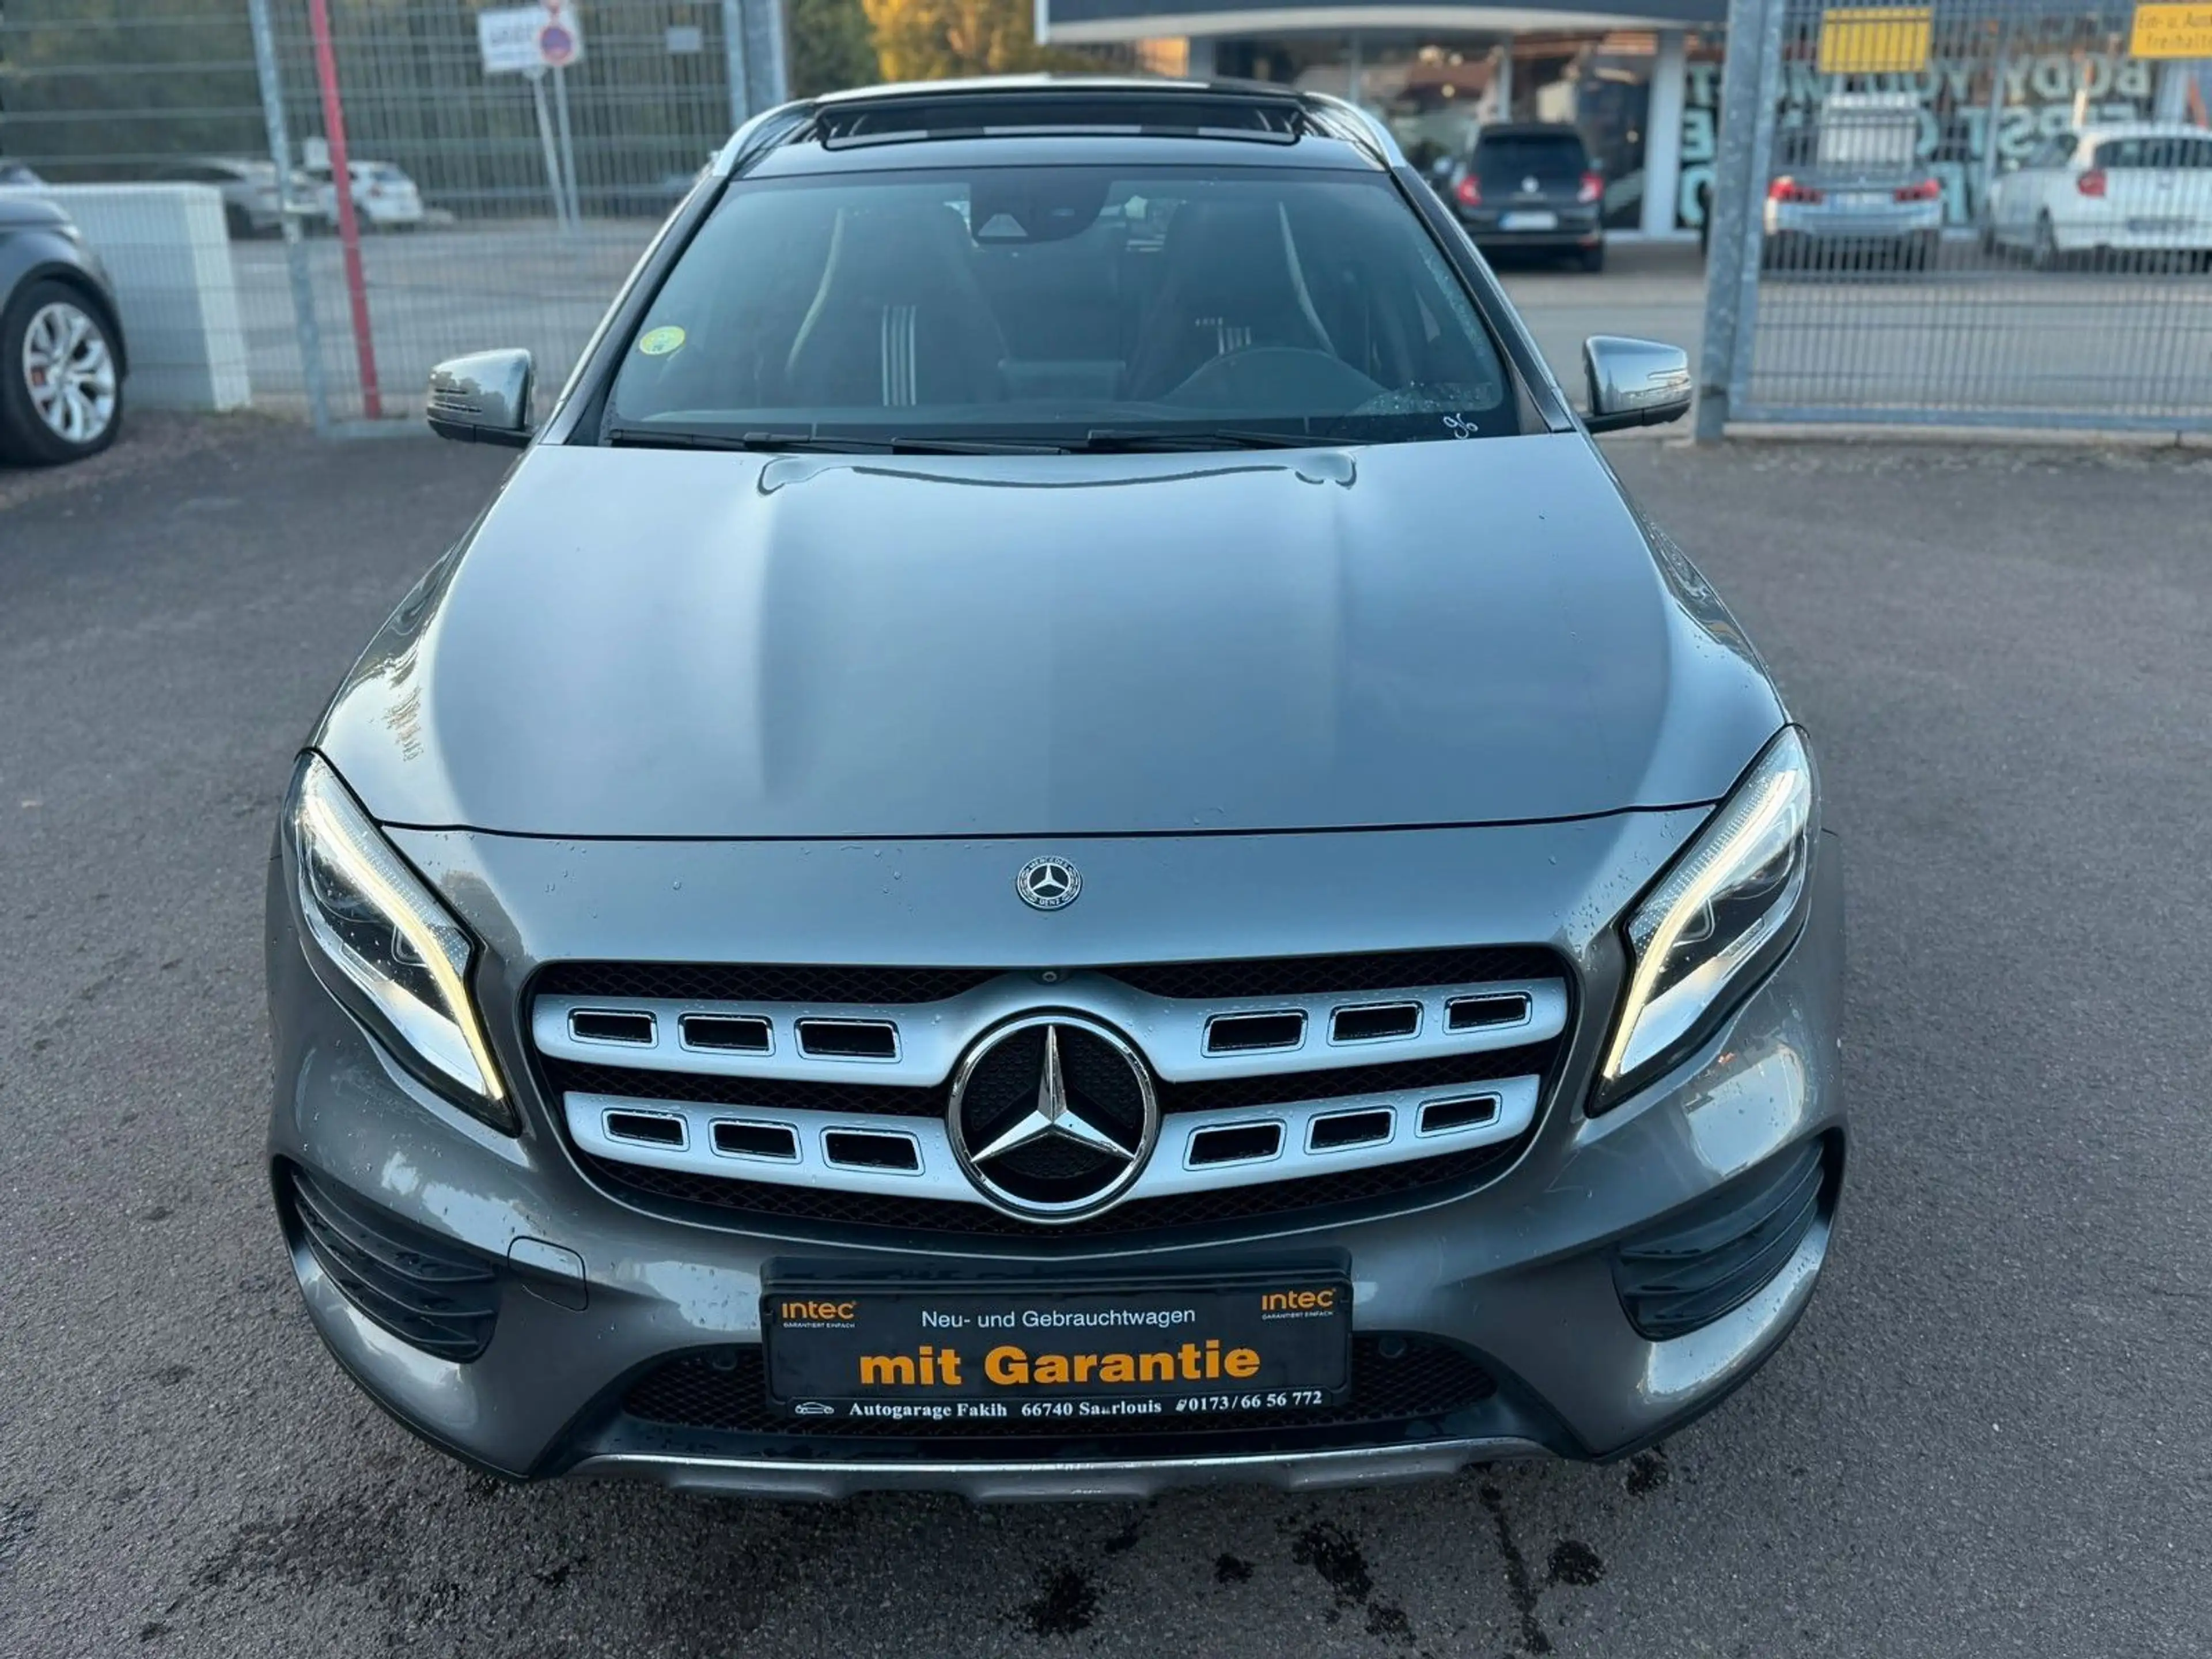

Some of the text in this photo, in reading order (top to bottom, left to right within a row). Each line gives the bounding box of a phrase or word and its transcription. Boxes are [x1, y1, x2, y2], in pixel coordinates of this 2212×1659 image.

[782, 1301, 854, 1319] intec
[1262, 1290, 1334, 1310] intec
[922, 1309, 1196, 1327] Neu- und Gebrauchtwagen
[860, 1339, 1260, 1384] mit Garantie
[849, 1403, 952, 1420] Autogarage
[957, 1403, 1007, 1417] Fakih
[1022, 1402, 1073, 1417] 66740
[1267, 1393, 1287, 1407] 56
[1293, 1390, 1323, 1406] 772
